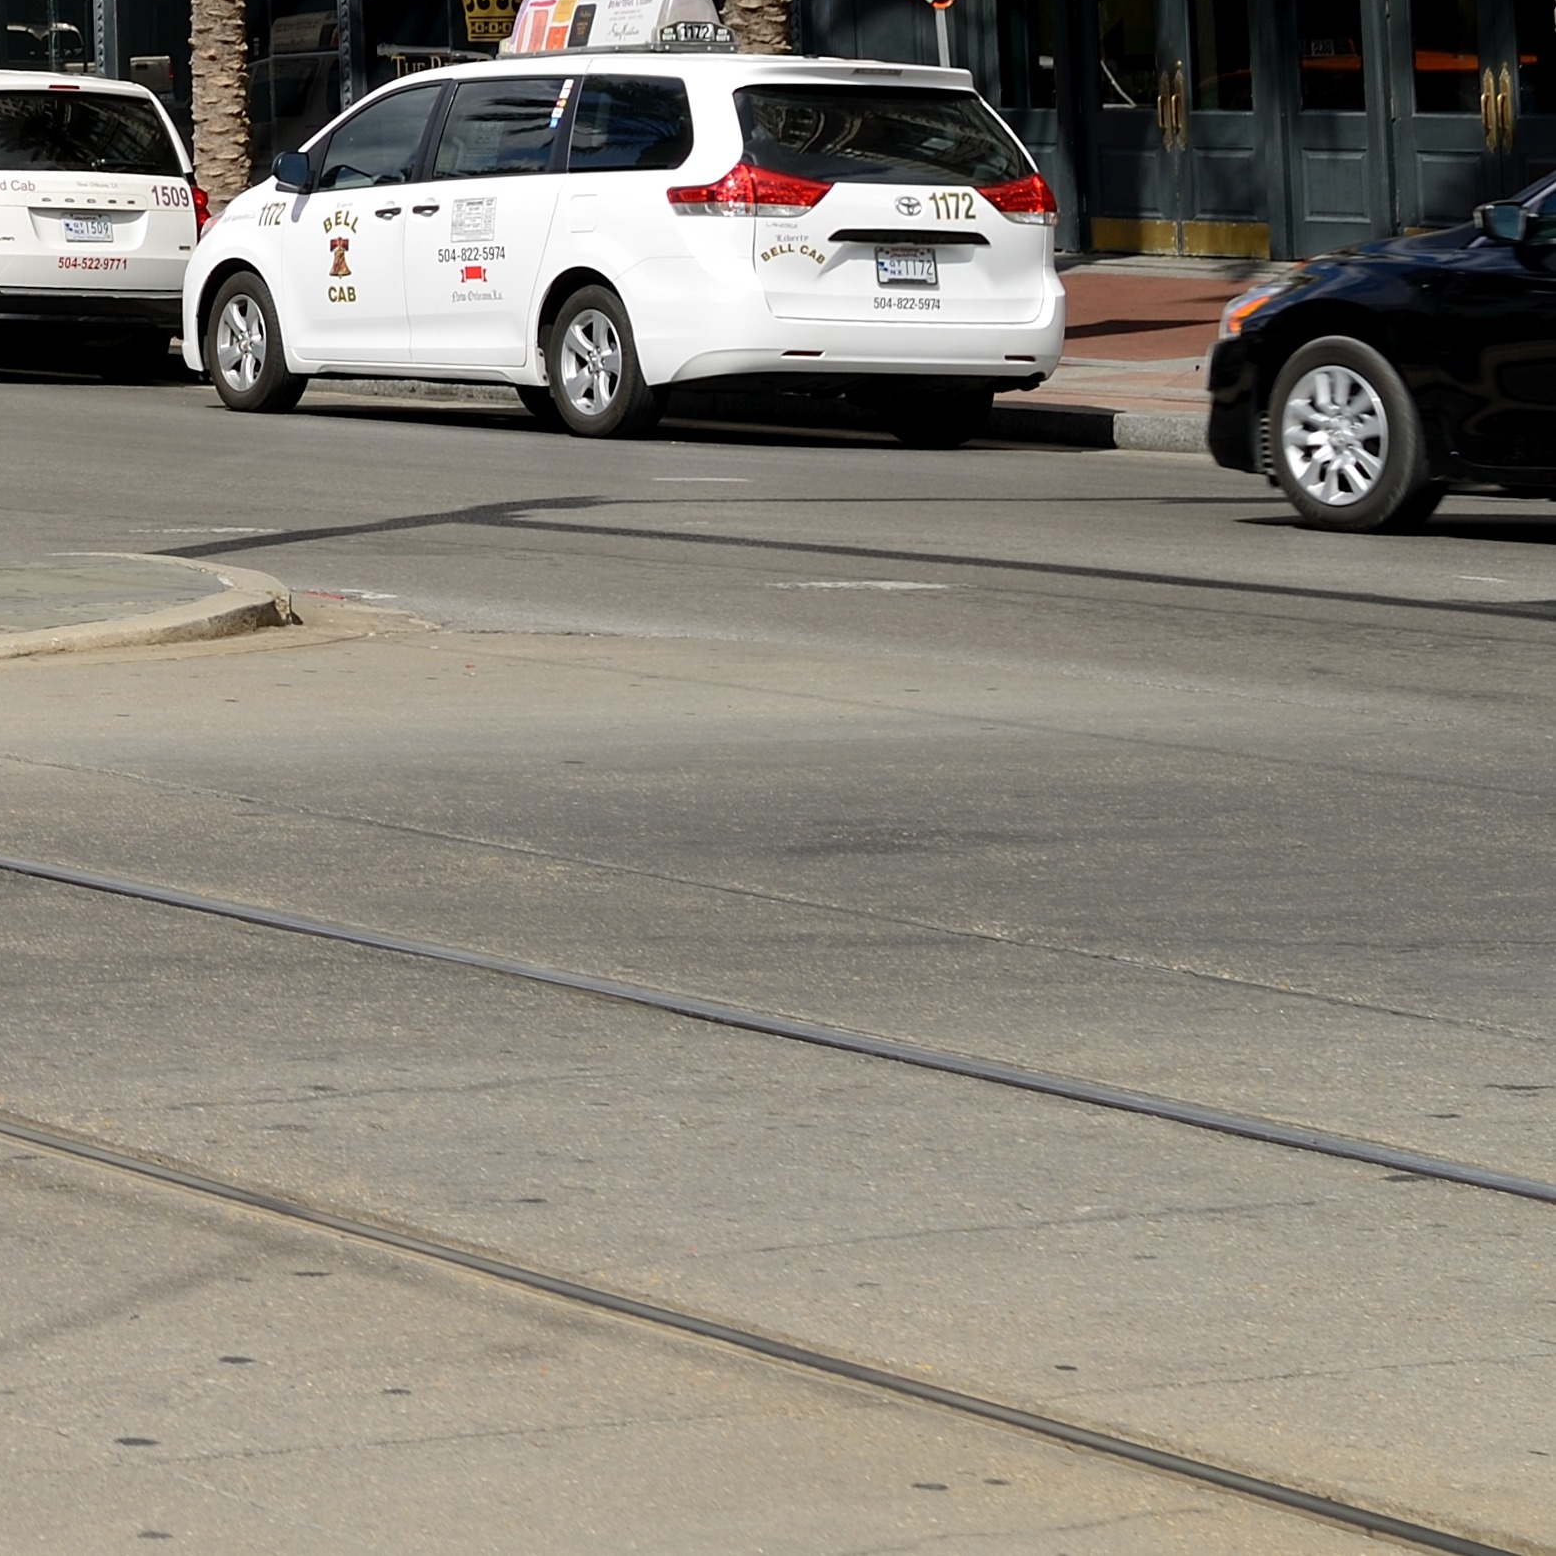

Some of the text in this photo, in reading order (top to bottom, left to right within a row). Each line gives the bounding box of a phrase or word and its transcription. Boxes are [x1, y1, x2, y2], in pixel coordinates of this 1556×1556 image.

[681, 24, 711, 40] 1172
[10, 180, 36, 193] Cab
[151, 185, 190, 208] 1509
[257, 202, 287, 227] 1172
[928, 191, 977, 221] 1172
[86, 221, 109, 235] 1509
[322, 209, 360, 234] BELL
[437, 245, 506, 263] 504-822-5974
[760, 243, 826, 265] BELL CAB
[58, 257, 128, 270] 504-522-9771
[905, 259, 934, 276] 1172
[328, 286, 357, 303] CAB
[873, 296, 941, 310] 504-822-5974
